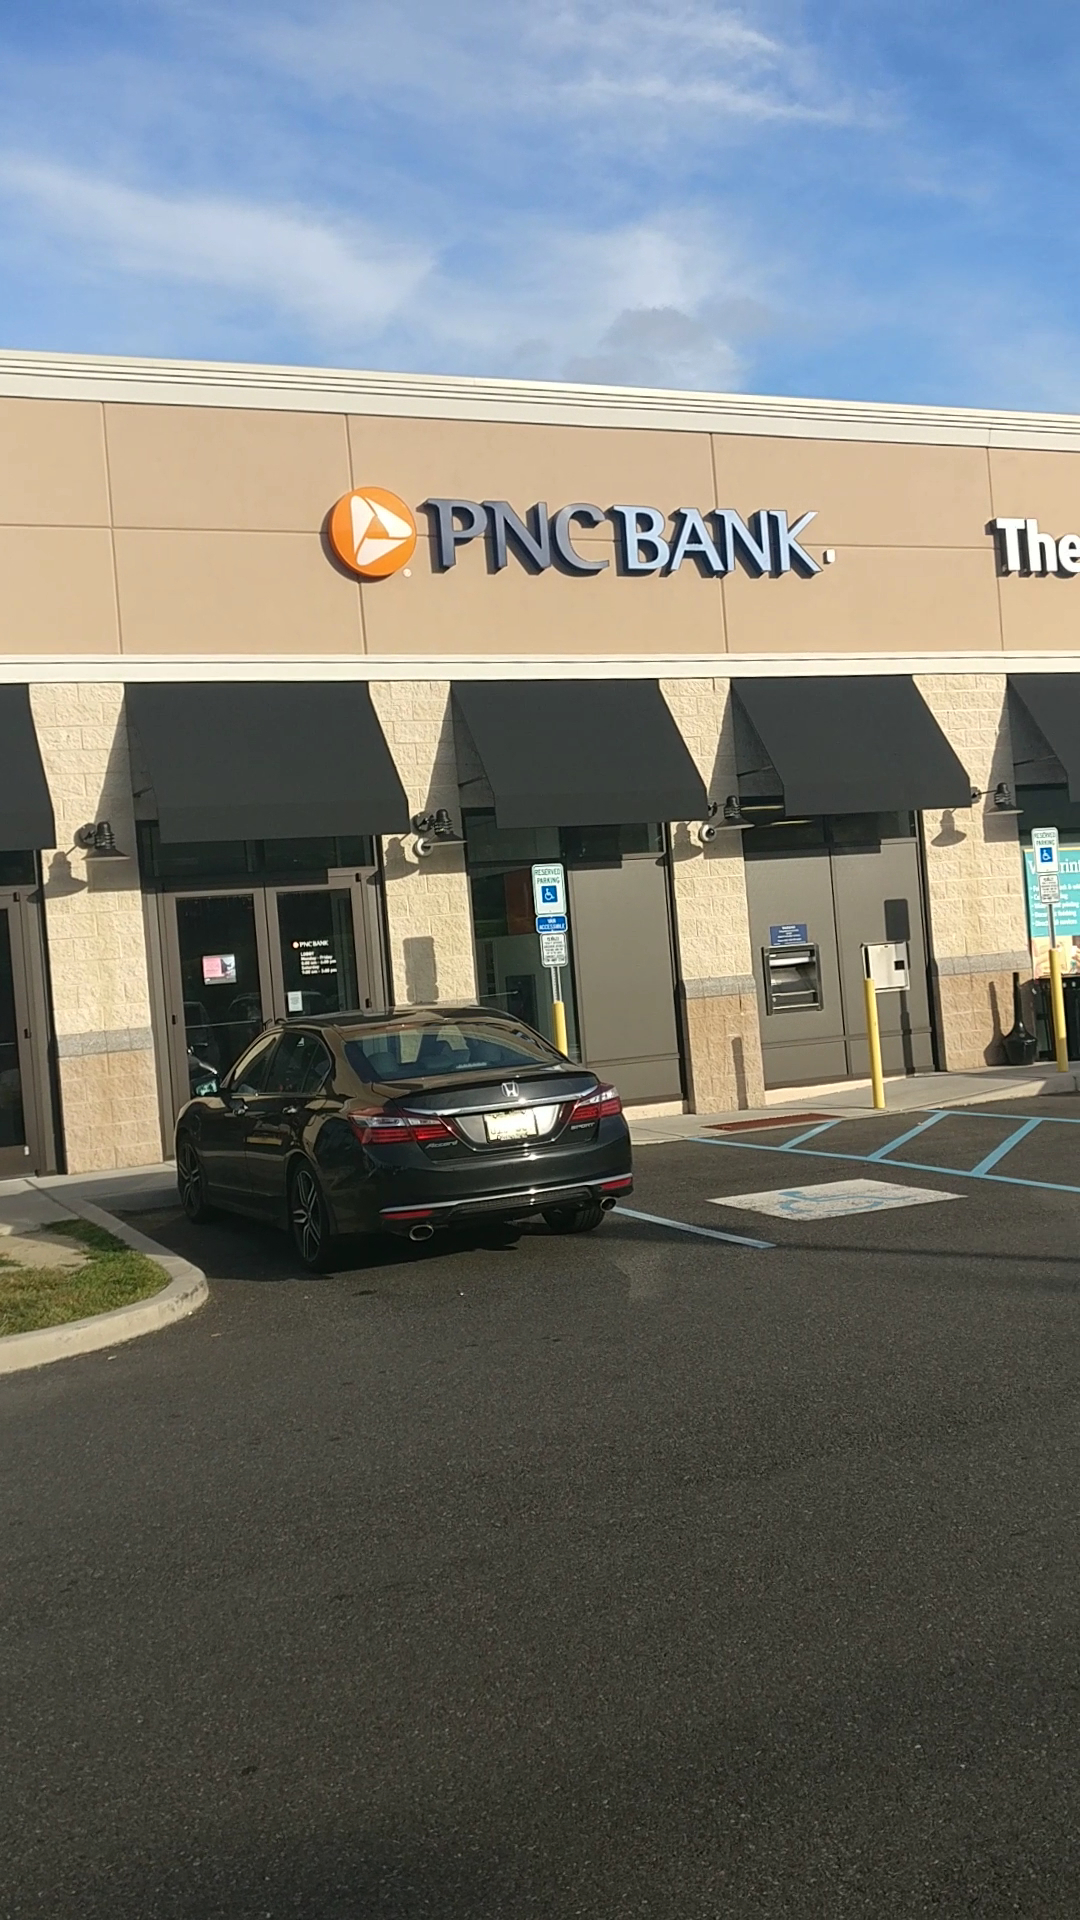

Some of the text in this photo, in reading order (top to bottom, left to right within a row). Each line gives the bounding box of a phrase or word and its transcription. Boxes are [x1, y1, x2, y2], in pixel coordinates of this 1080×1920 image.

[424, 498, 823, 578] PNC BANK
[989, 517, 1080, 577] The
[534, 868, 561, 876] RESERVED
[536, 876, 560, 884] PARKING
[571, 1122, 595, 1130] SPORT
[425, 1140, 458, 1149] Accord
